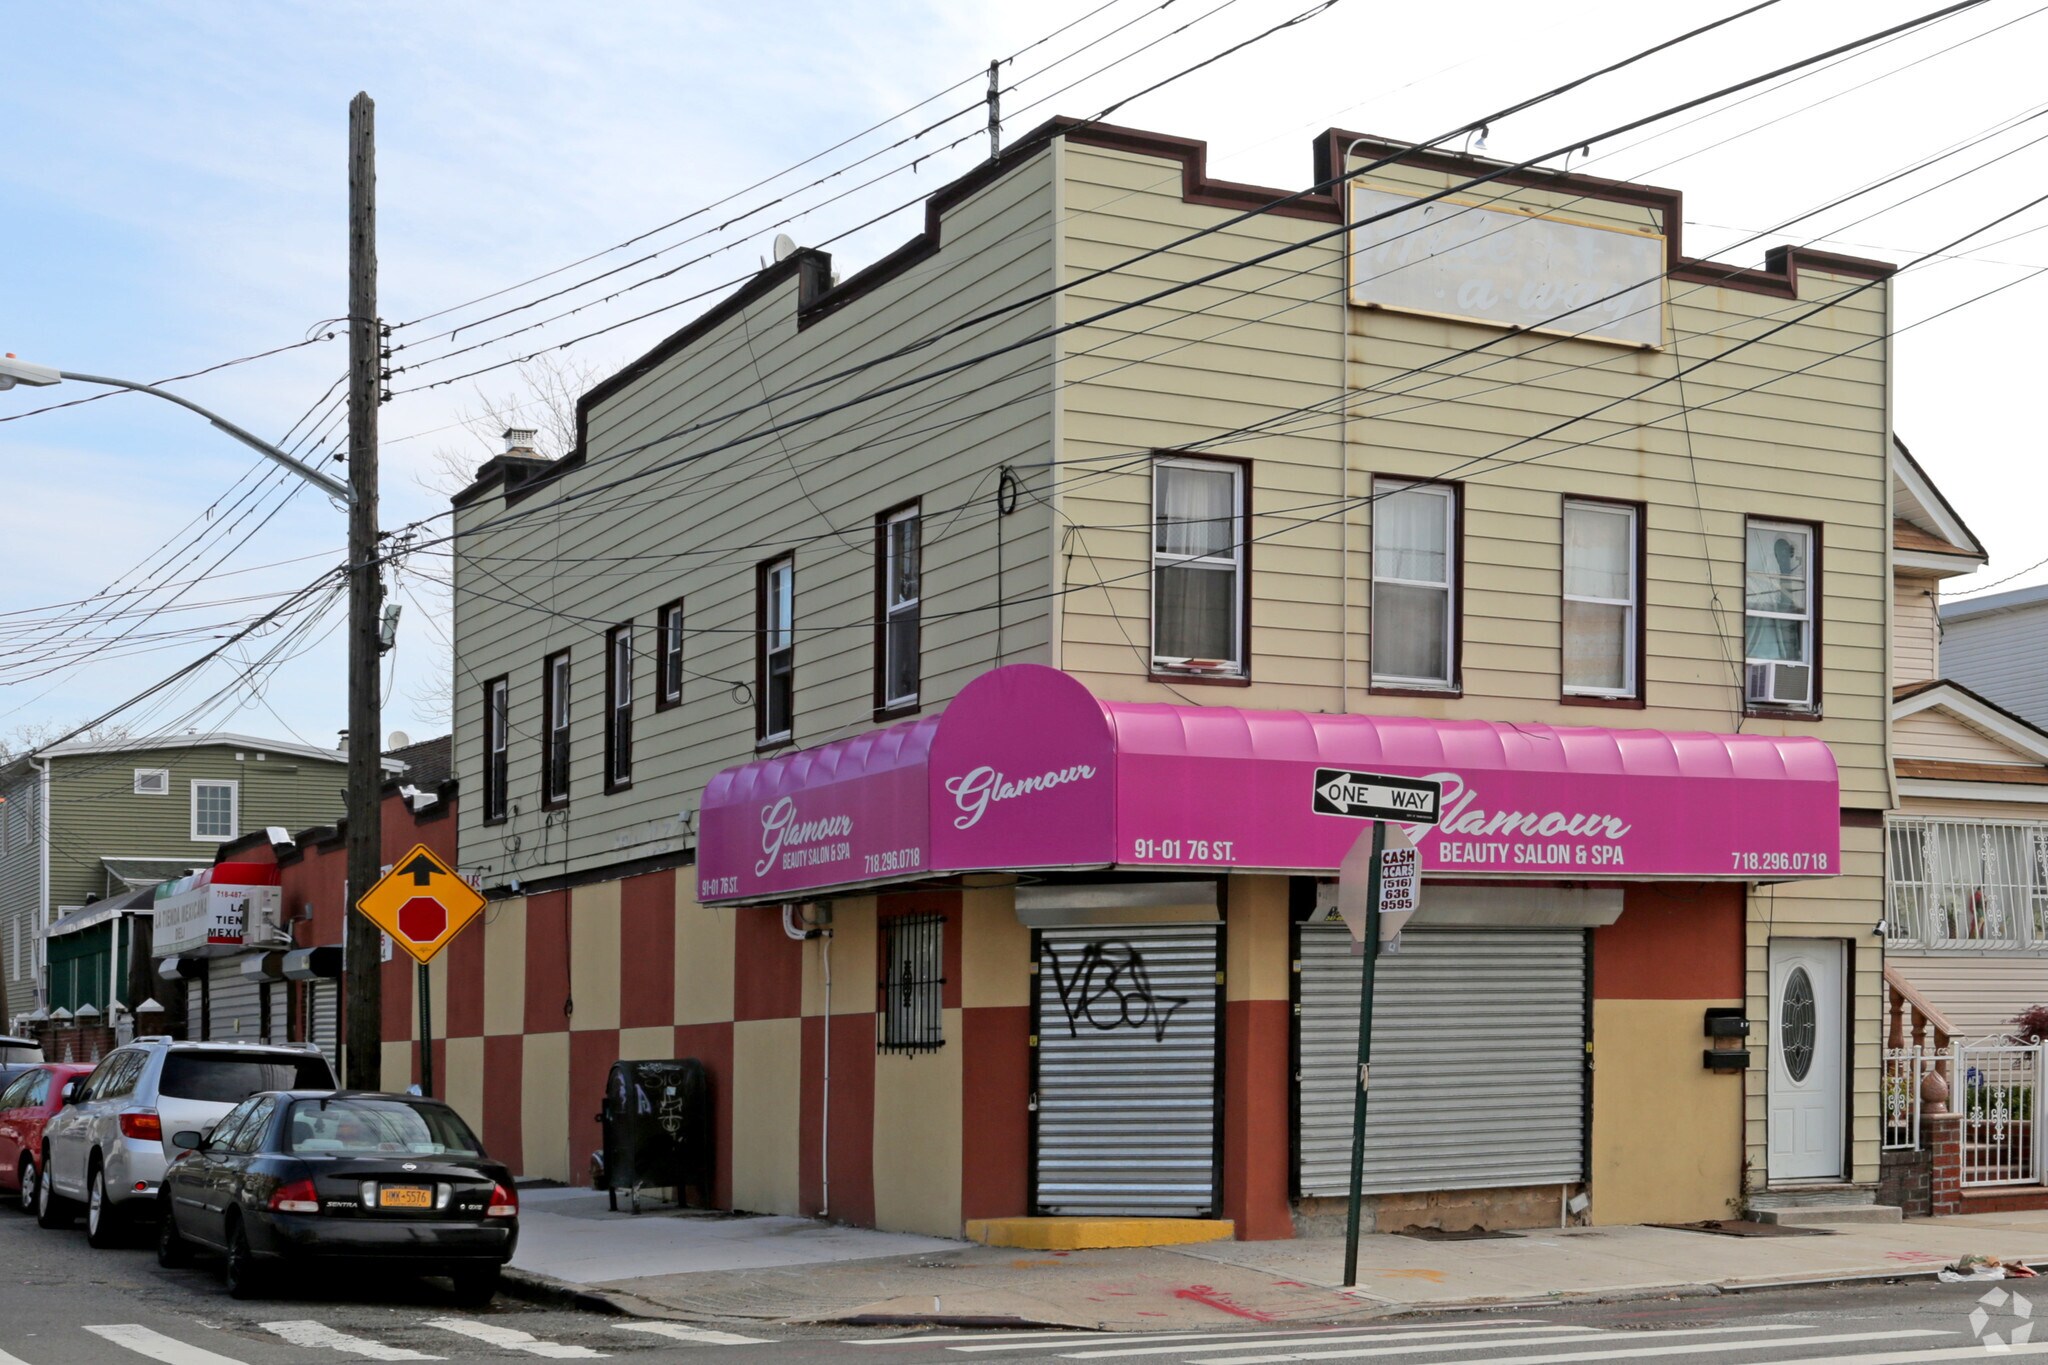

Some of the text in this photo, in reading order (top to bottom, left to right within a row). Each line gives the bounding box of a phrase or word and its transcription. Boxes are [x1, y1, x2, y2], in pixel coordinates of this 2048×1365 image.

[945, 764, 1097, 830] Glamour
[1328, 784, 1429, 810] ONE WAY
[755, 796, 853, 877] Glamour
[782, 843, 850, 870] BEAUTY SALON & SPA
[1134, 838, 1236, 861] 91-01 76 ST.
[1439, 842, 1624, 865] BEAUTY SALON & SPA
[864, 847, 920, 874] 718.296.0718
[1731, 852, 1828, 870] 718.296.0718
[702, 877, 739, 896] 91-01 76 ST.
[1384, 878, 1412, 889] (516)
[216, 890, 247, 898] 718-487-
[1385, 889, 1410, 900] 636
[1381, 899, 1413, 910] 9595
[216, 915, 243, 925] TIEN
[325, 1200, 359, 1208] SENTRA
